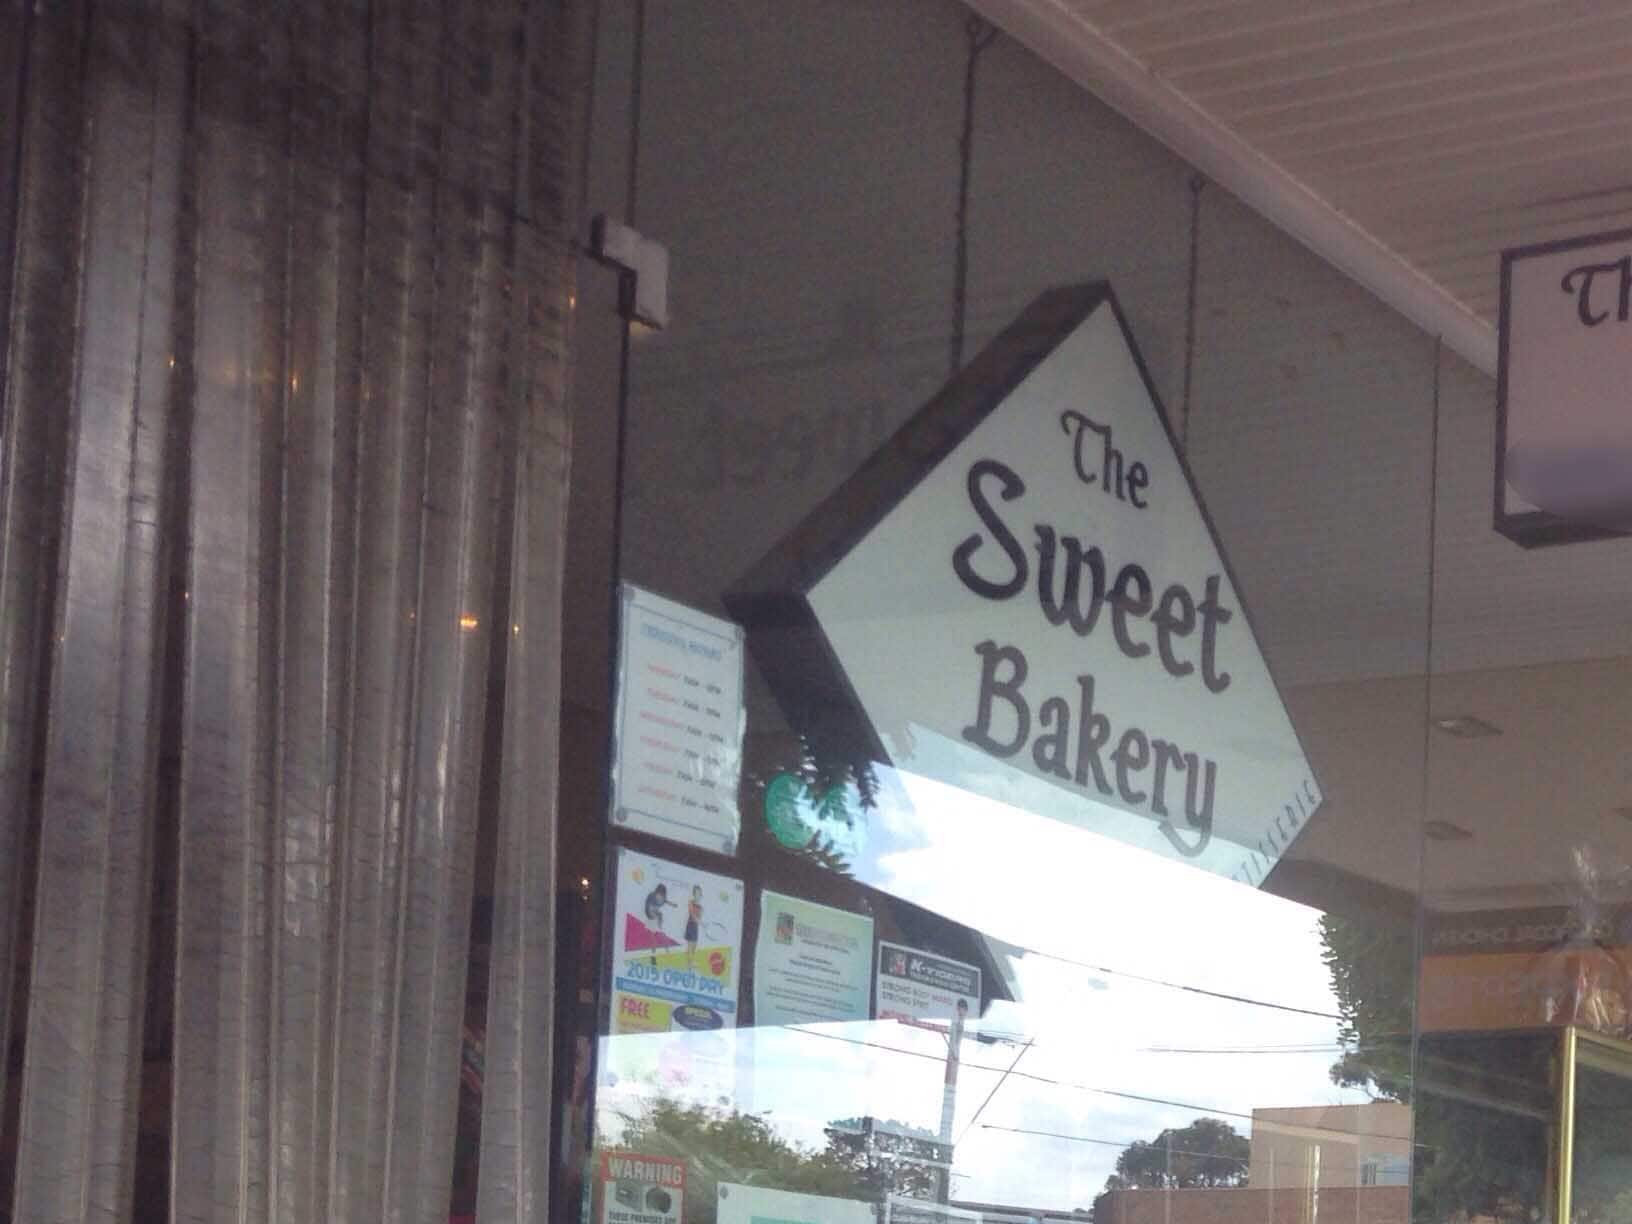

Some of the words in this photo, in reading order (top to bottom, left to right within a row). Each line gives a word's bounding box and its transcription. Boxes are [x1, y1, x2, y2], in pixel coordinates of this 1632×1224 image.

[1061, 409, 1149, 509] The
[952, 459, 1232, 694] Sweet
[962, 640, 1216, 858] Bakery
[608, 1157, 683, 1185] WARNING
